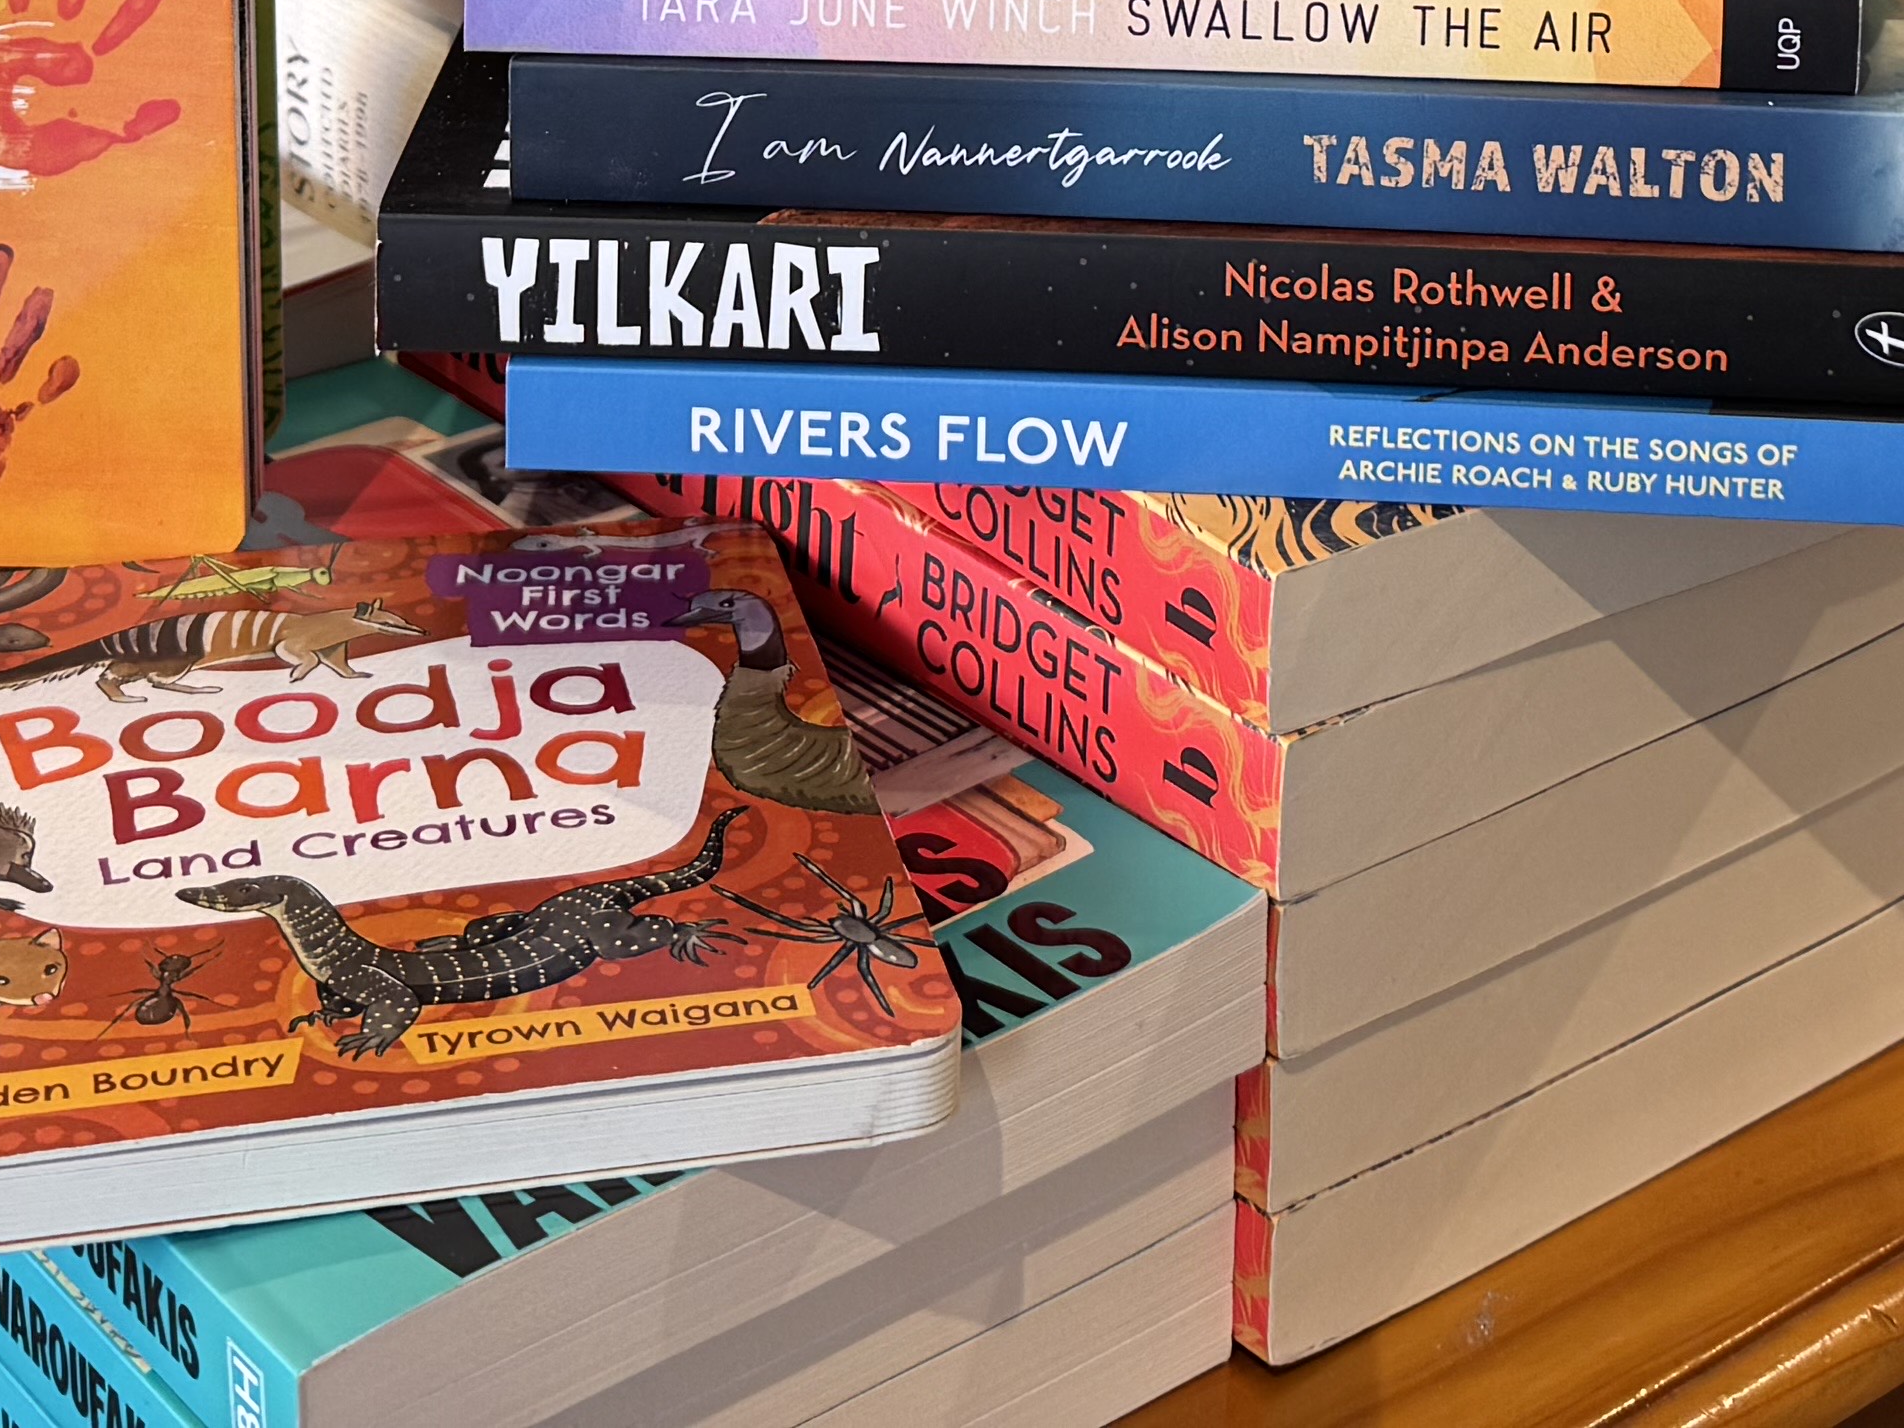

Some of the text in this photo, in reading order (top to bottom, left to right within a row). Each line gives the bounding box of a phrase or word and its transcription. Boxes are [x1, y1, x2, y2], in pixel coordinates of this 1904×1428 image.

[759, 137, 858, 169] am
[878, 127, 1232, 185] Nannertgarrook
[1304, 130, 1510, 191] TASMA
[1529, 138, 1784, 206] WALTON
[482, 235, 882, 353] YILKARI
[688, 404, 1130, 469] RIVERS FLOW
[1328, 421, 1800, 467] REFLECTIONS ON THE SONGS OF
[1337, 455, 1784, 502] ARCHIE ROACH & RUBY HUNTER
[456, 557, 686, 587] Noongar
[521, 583, 622, 608] First
[488, 604, 653, 634] Words
[916, 620, 1118, 784] COLLINS
[105, 723, 649, 845] Barna
[98, 799, 616, 886] Land Creatures
